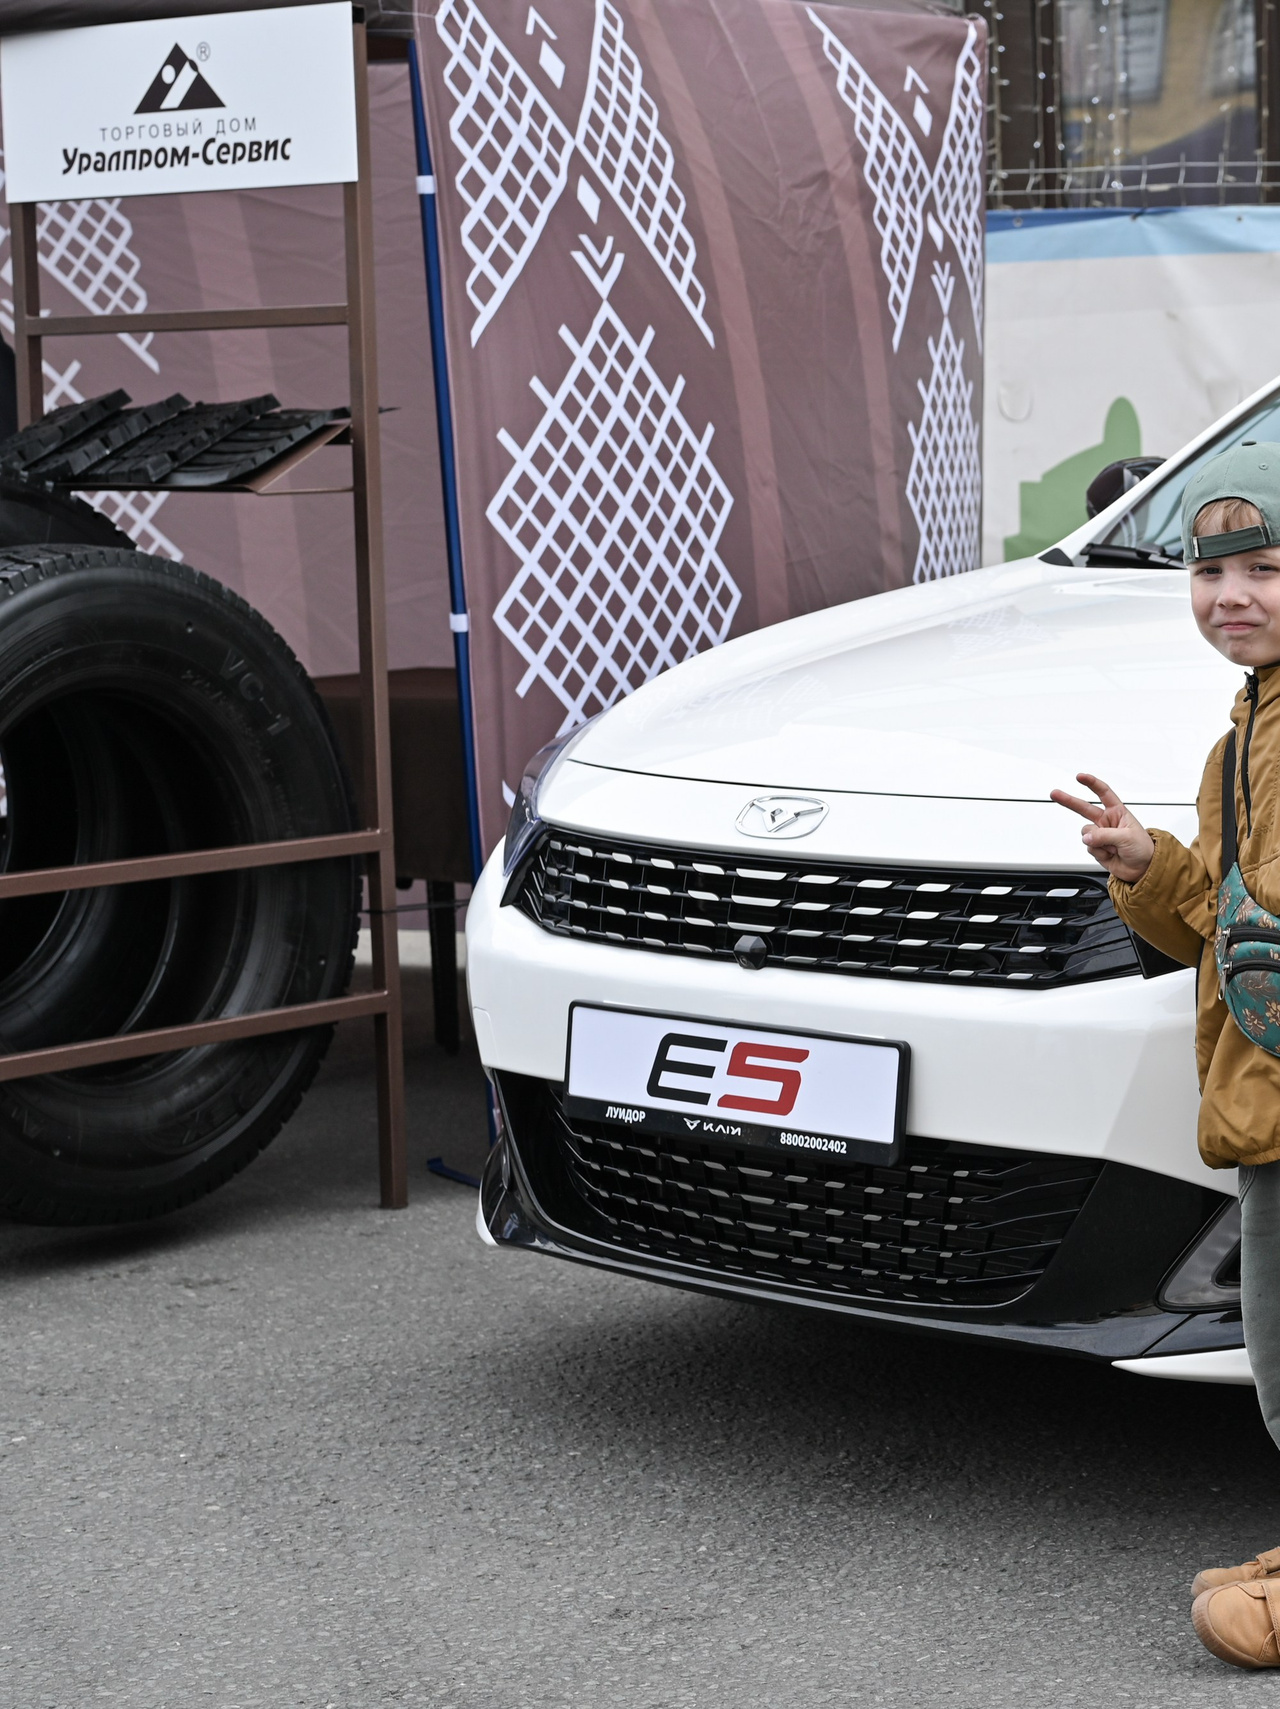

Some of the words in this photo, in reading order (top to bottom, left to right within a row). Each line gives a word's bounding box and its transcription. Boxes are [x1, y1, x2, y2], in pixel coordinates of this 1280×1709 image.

[100, 118, 203, 142] ТОРГОВЫЙ
[215, 117, 257, 136] ДОМ
[62, 137, 292, 175] Уралпром-Сервис
[646, 1032, 810, 1116] ES
[605, 1105, 646, 1124] ЛУИДОР
[780, 1131, 847, 1154] 88002002402
